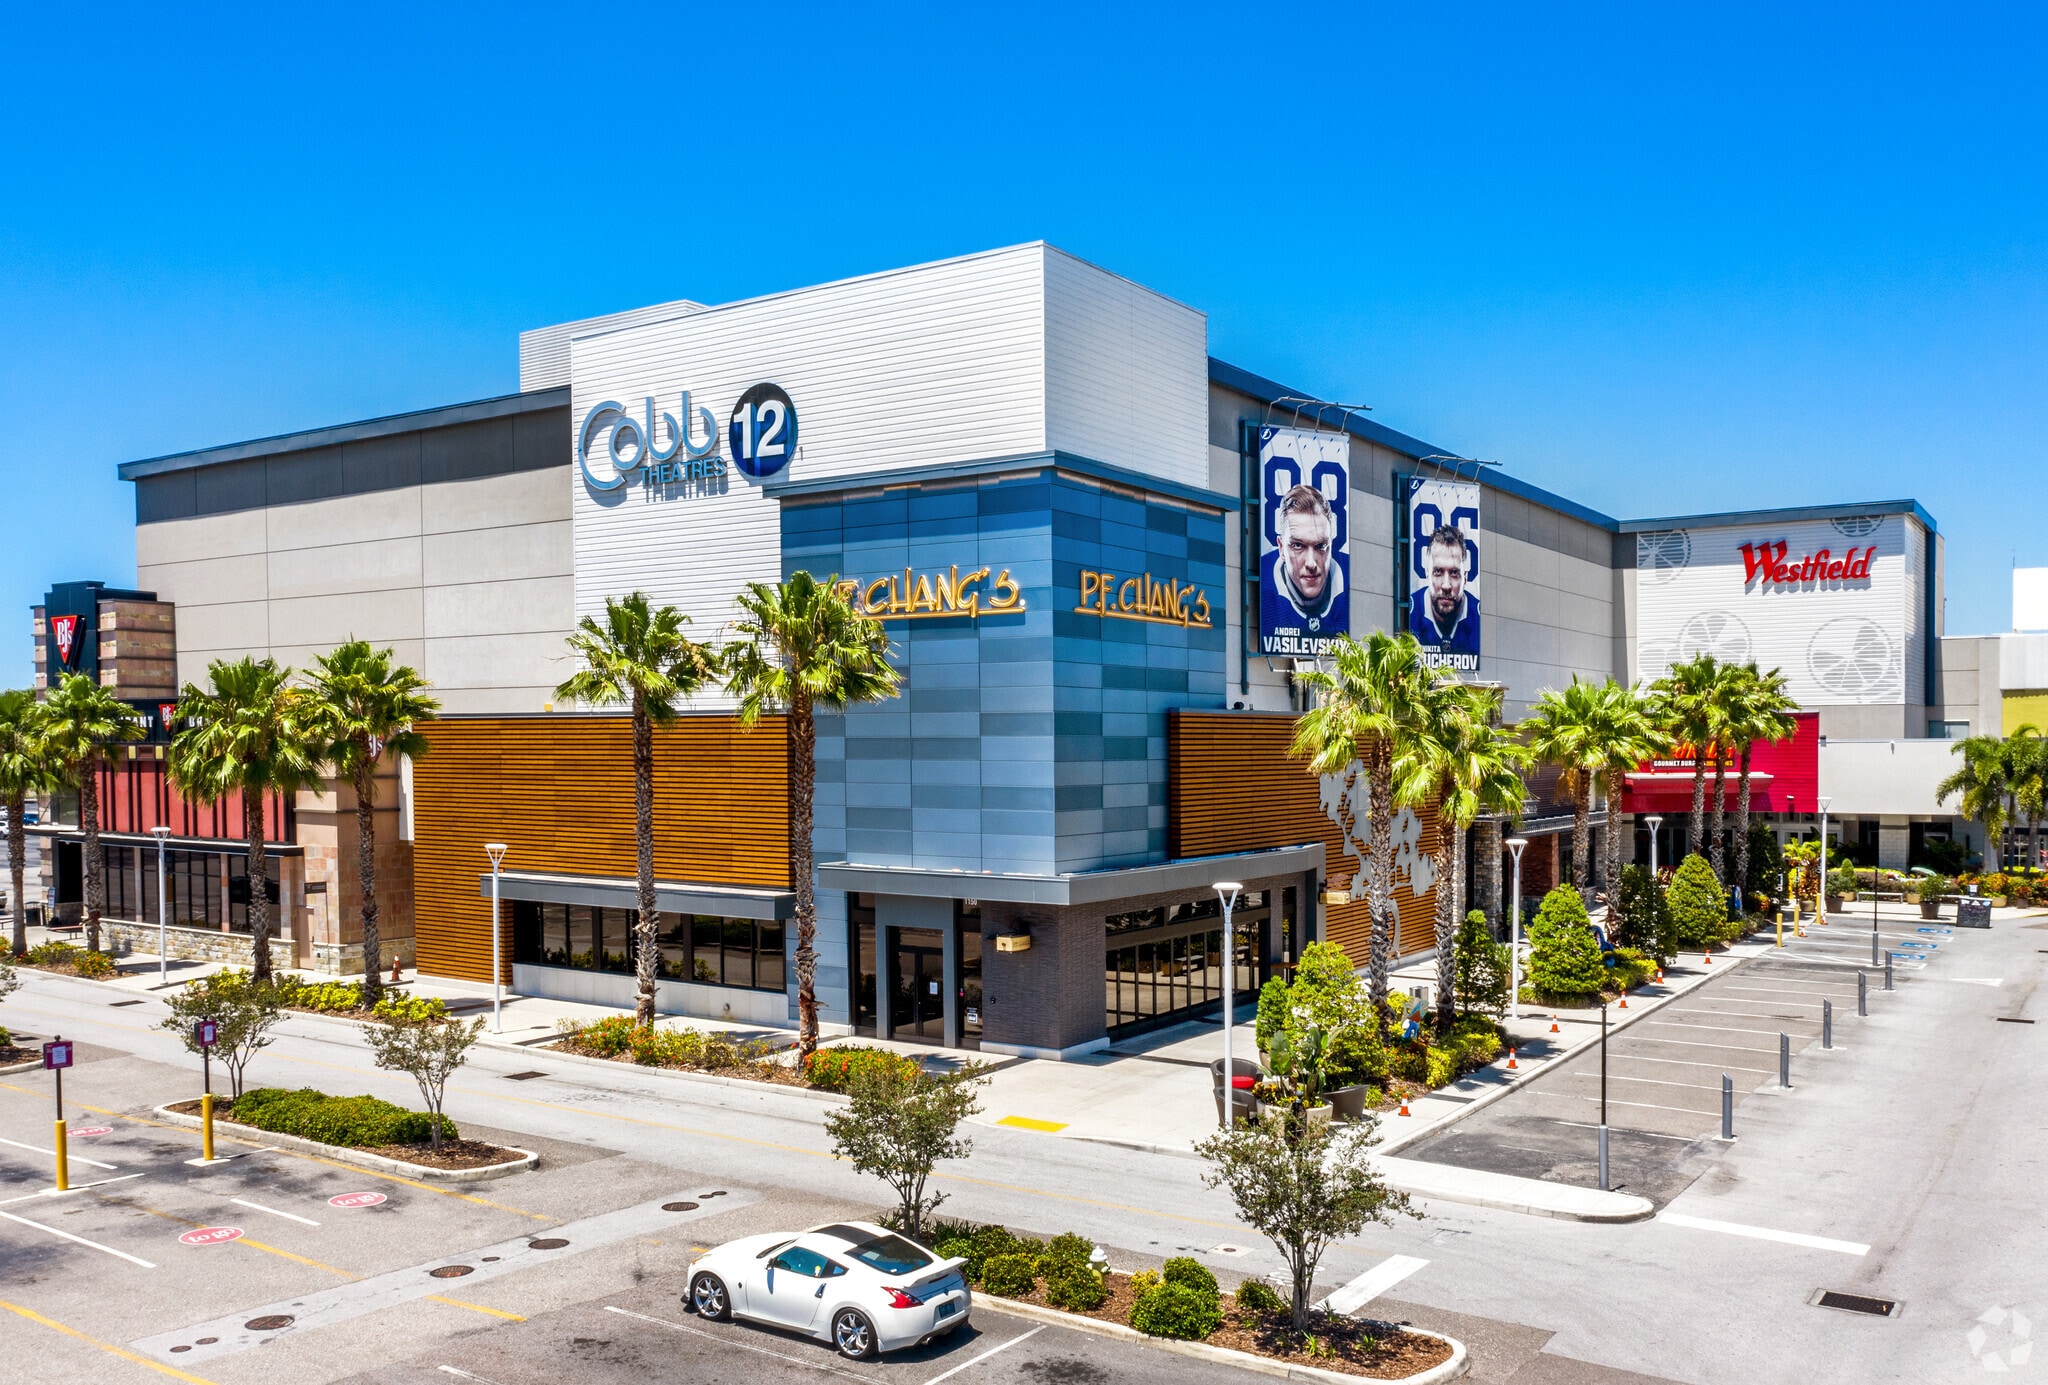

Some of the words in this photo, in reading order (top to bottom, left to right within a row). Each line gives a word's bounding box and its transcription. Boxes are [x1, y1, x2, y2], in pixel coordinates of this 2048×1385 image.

[578, 391, 720, 491] Cobb
[733, 400, 786, 459] 12
[639, 457, 728, 486] THEATRES
[1264, 456, 1347, 548] 88
[1413, 502, 1479, 583] 86
[1737, 540, 1877, 585] Westfield
[1274, 627, 1300, 636] ANDREI
[1415, 653, 1478, 671] UCHEROV
